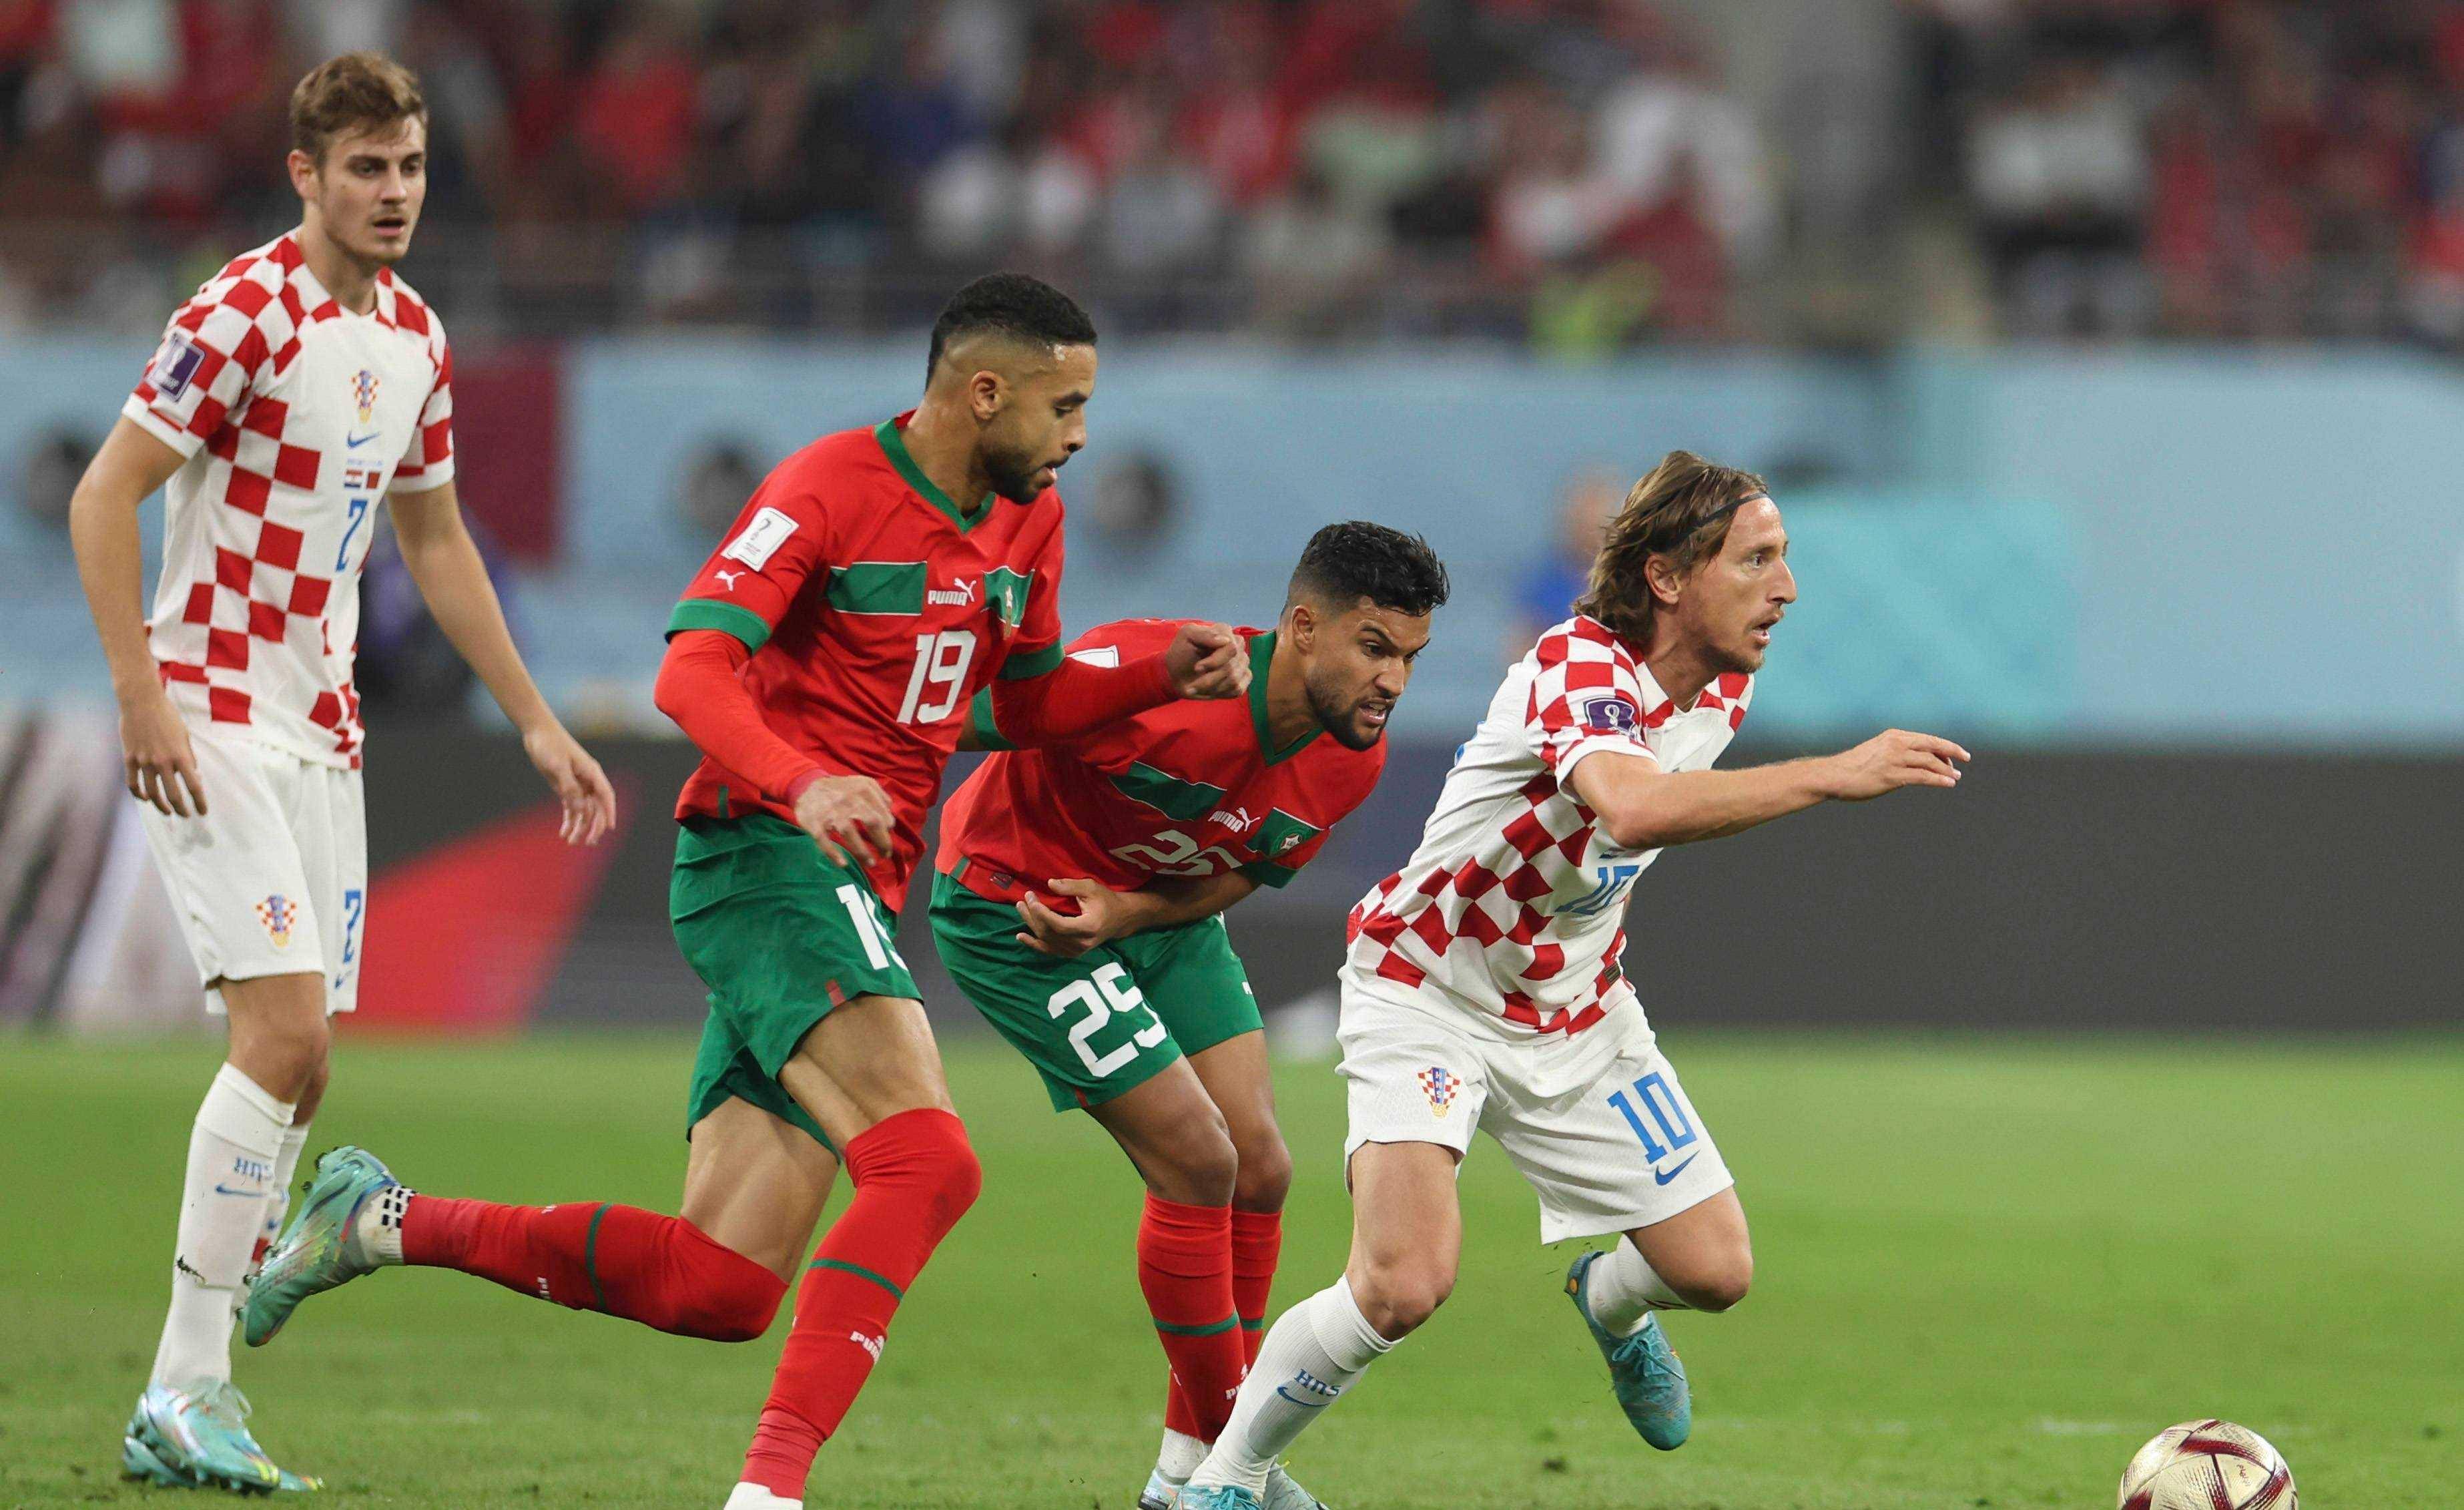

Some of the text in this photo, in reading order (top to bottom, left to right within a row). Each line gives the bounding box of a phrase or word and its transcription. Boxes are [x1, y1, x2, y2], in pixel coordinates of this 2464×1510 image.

[928, 589, 968, 607] PUMA
[896, 630, 978, 725] 19
[1207, 810, 1245, 833] PUMA
[1047, 961, 1168, 1078] 25
[1606, 1071, 1698, 1164] 10
